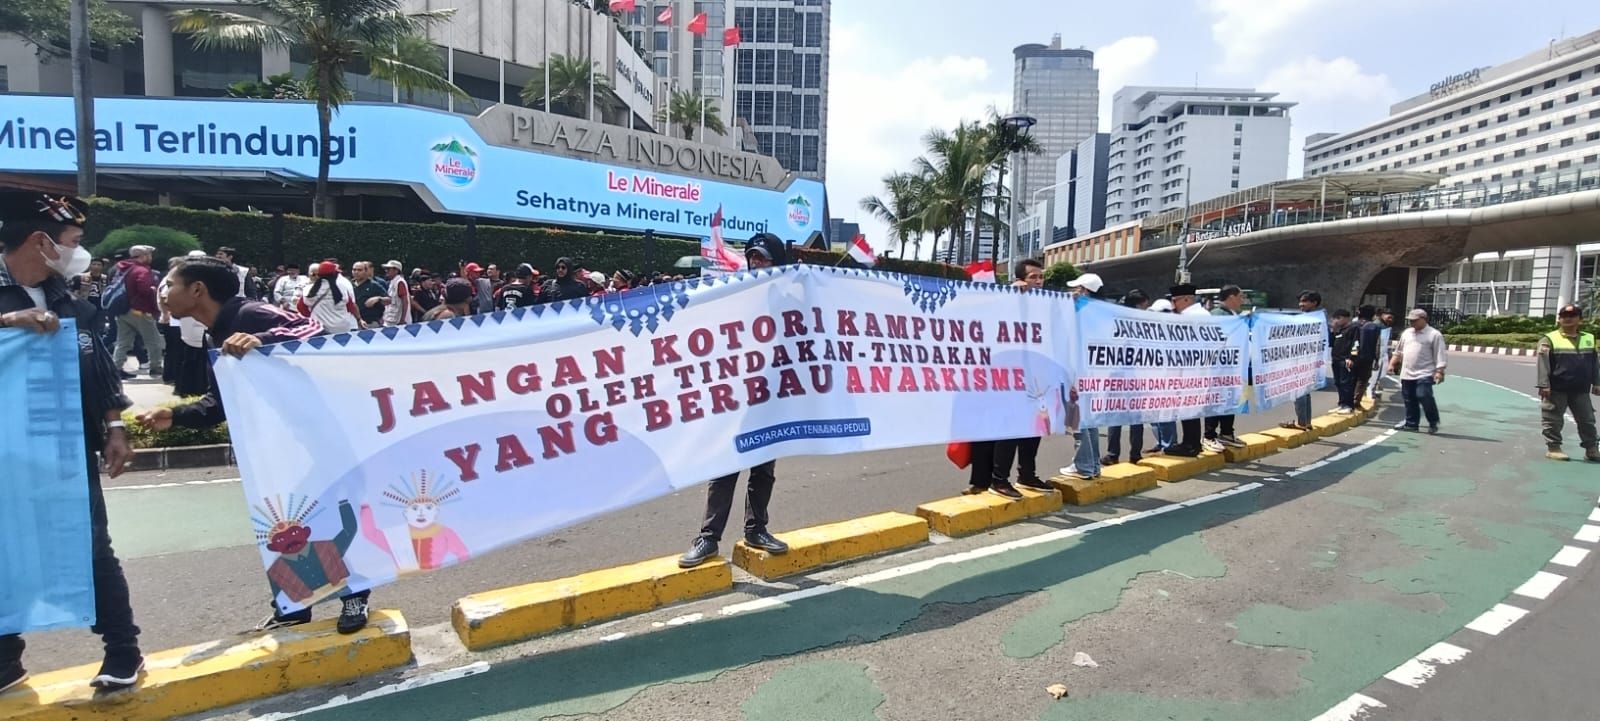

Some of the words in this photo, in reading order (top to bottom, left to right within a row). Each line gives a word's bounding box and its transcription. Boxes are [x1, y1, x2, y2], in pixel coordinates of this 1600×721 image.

[135, 122, 357, 165] Terlindungi
[511, 112, 618, 158] PLAZA
[628, 134, 767, 184] INDONESIA
[450, 157, 461, 168] Le
[608, 171, 628, 191] Le
[516, 190, 611, 218] Sehatnya
[617, 202, 680, 224] Mineral
[684, 210, 768, 234] Terlndungi
[1228, 221, 1252, 236] ASTRA
[1113, 319, 1165, 341] JAKARTA
[1167, 325, 1199, 341] KOTA
[1088, 345, 1163, 367] TENABANG
[1166, 350, 1217, 366] KAMPUNG
[1219, 350, 1240, 365] GUE
[371, 345, 626, 433] JANGAN
[651, 307, 825, 367] KOTORI
[836, 309, 984, 343] KAMPUNG
[996, 320, 1043, 344] ANE
[545, 373, 657, 419] OLEH
[674, 338, 992, 390] TINDAKAN-TINDAKAN
[1079, 379, 1101, 392] BUAT
[1103, 377, 1146, 391] PERUSUH
[1149, 377, 1166, 390] DAN
[1091, 399, 1101, 412] LU
[1105, 398, 1126, 411] JUAL
[1128, 397, 1147, 410] GUE
[1149, 396, 1182, 409] BORONG
[444, 411, 618, 482] YANG
[642, 363, 833, 432] BERBAU
[846, 365, 1026, 393] ANARKISME
[740, 426, 801, 449] MASYARAKAT
[844, 422, 869, 433] PEDULI
